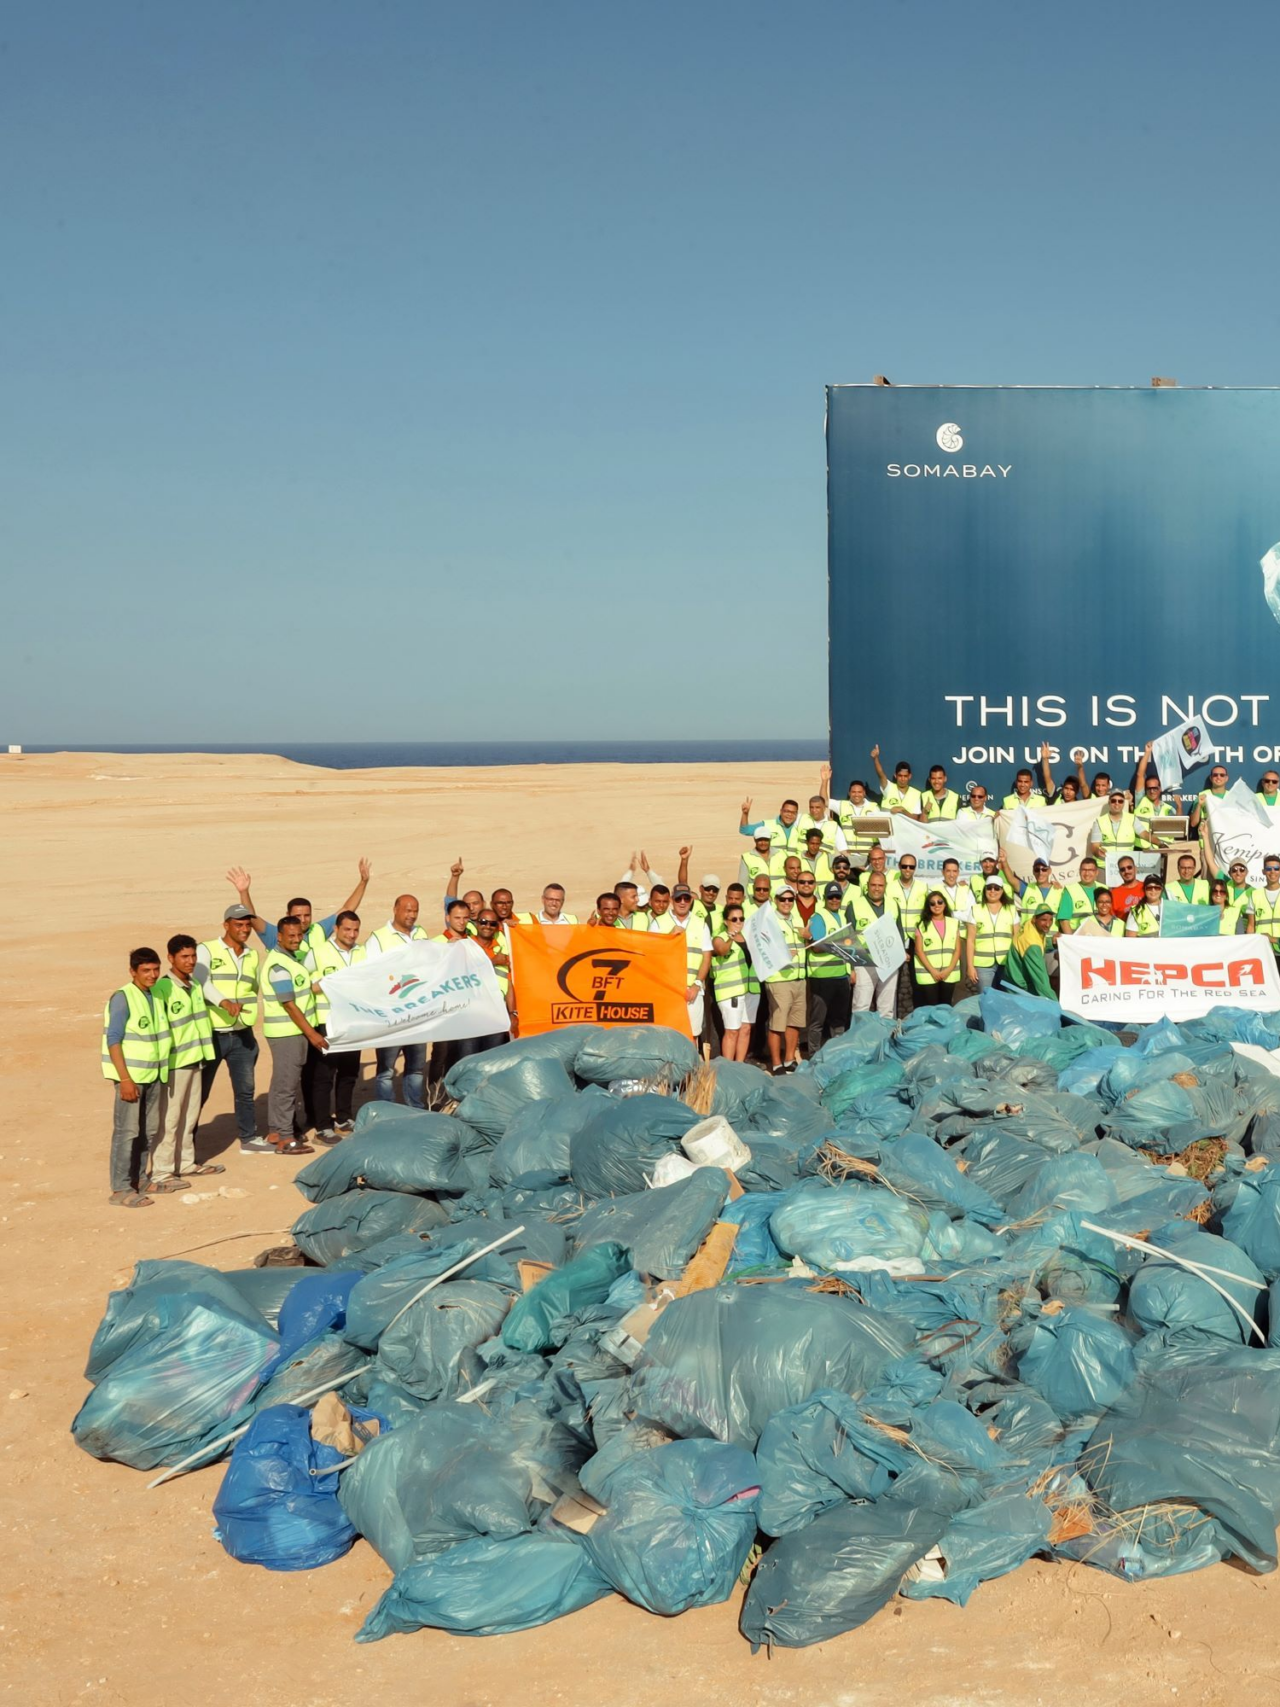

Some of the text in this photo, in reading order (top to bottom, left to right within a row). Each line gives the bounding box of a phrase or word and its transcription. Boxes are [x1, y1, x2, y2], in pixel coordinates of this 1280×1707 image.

[886, 463, 1012, 479] SOMABAY
[944, 695, 1067, 727] THIS
[1091, 694, 1137, 727] IS
[1161, 694, 1270, 727] NOT
[952, 746, 1015, 764] JOIN
[1024, 746, 1061, 764] US
[1069, 746, 1109, 763] ON
[1117, 746, 1152, 763] TH
[886, 857, 900, 869] TH
[1250, 875, 1268, 883] SIN
[1081, 956, 1265, 990] HEPCA
[591, 976, 626, 990] BFT
[347, 972, 483, 1019] THE BREAKERS
[555, 1005, 650, 1020] KITE HOUSE
